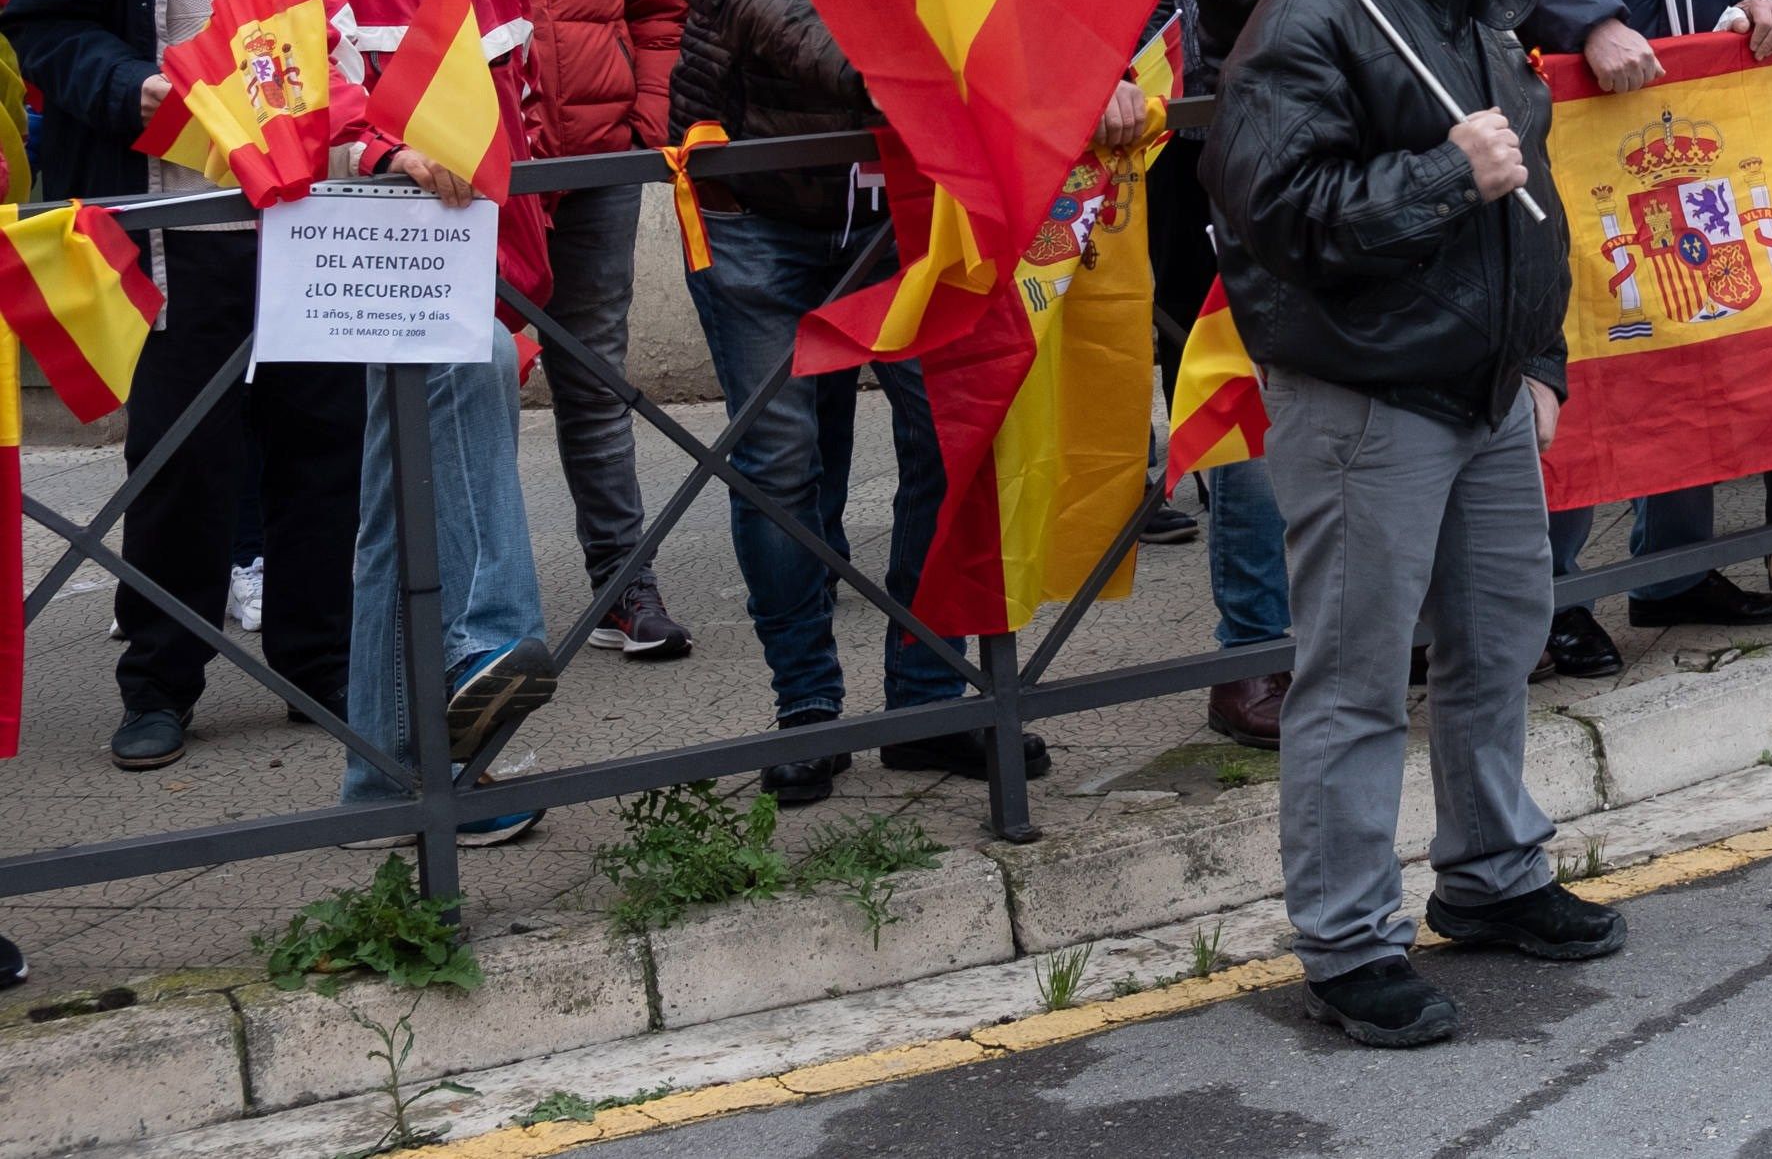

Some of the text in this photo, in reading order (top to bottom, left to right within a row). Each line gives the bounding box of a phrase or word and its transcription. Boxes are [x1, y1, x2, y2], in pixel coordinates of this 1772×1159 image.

[290, 226, 471, 242] HOY HACE 4.271 DIAS
[315, 254, 445, 270] DEL ATENTADO
[305, 283, 452, 299] ¿LO RECUERDAS?
[306, 309, 319, 319] 11
[322, 308, 353, 321] años,
[356, 309, 364, 320] 8
[366, 311, 406, 322] meses,
[409, 313, 417, 322] y
[418, 311, 426, 321] 9
[329, 328, 426, 337] 21 DE MARZO DE 2008
